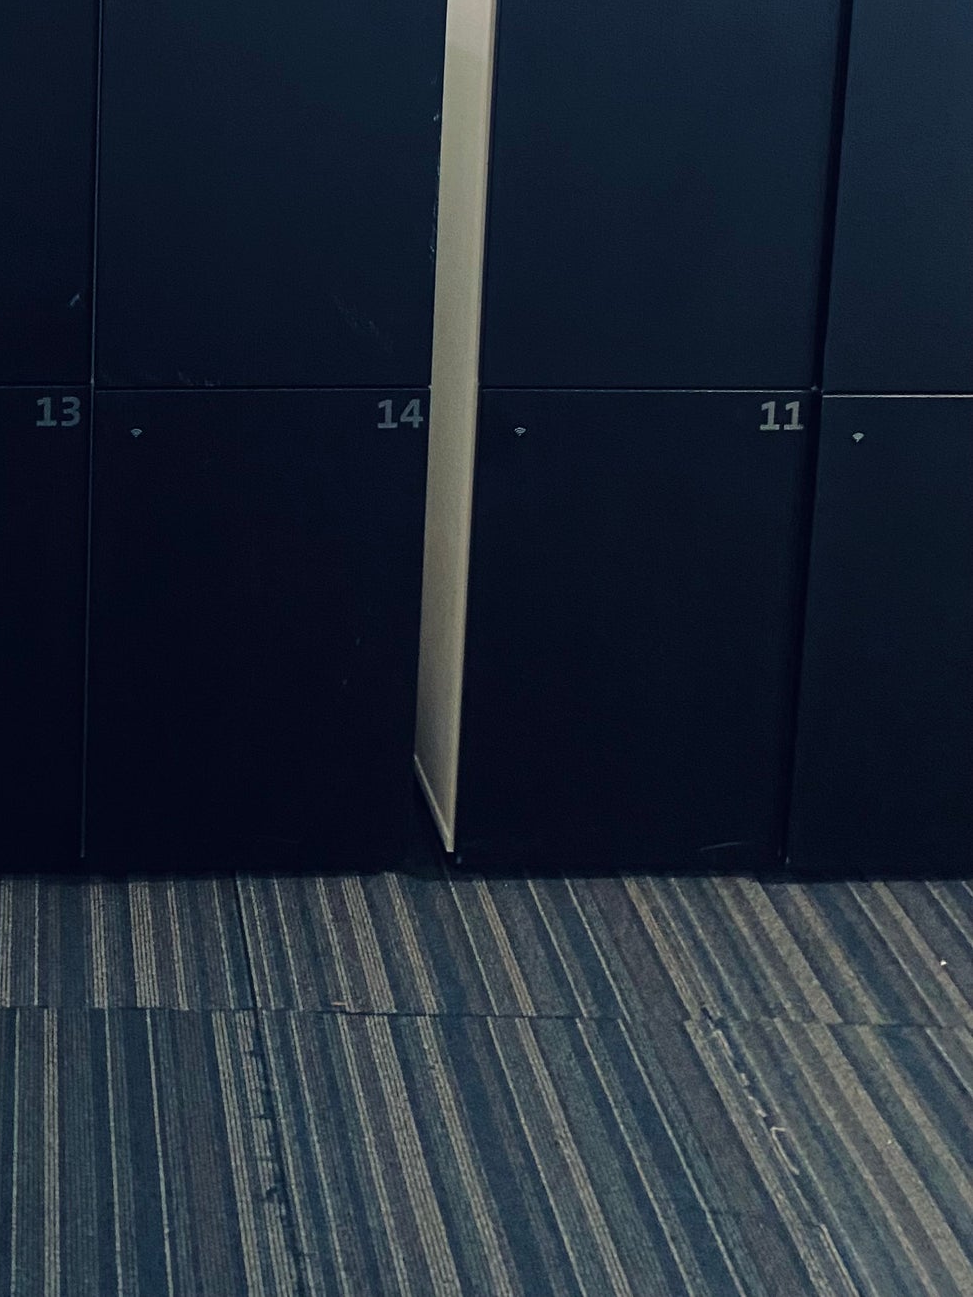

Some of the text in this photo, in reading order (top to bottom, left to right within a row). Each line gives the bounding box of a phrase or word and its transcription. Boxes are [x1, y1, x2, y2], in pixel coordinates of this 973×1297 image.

[35, 396, 81, 427] 13
[376, 398, 424, 429] 14
[758, 400, 804, 431] 11
